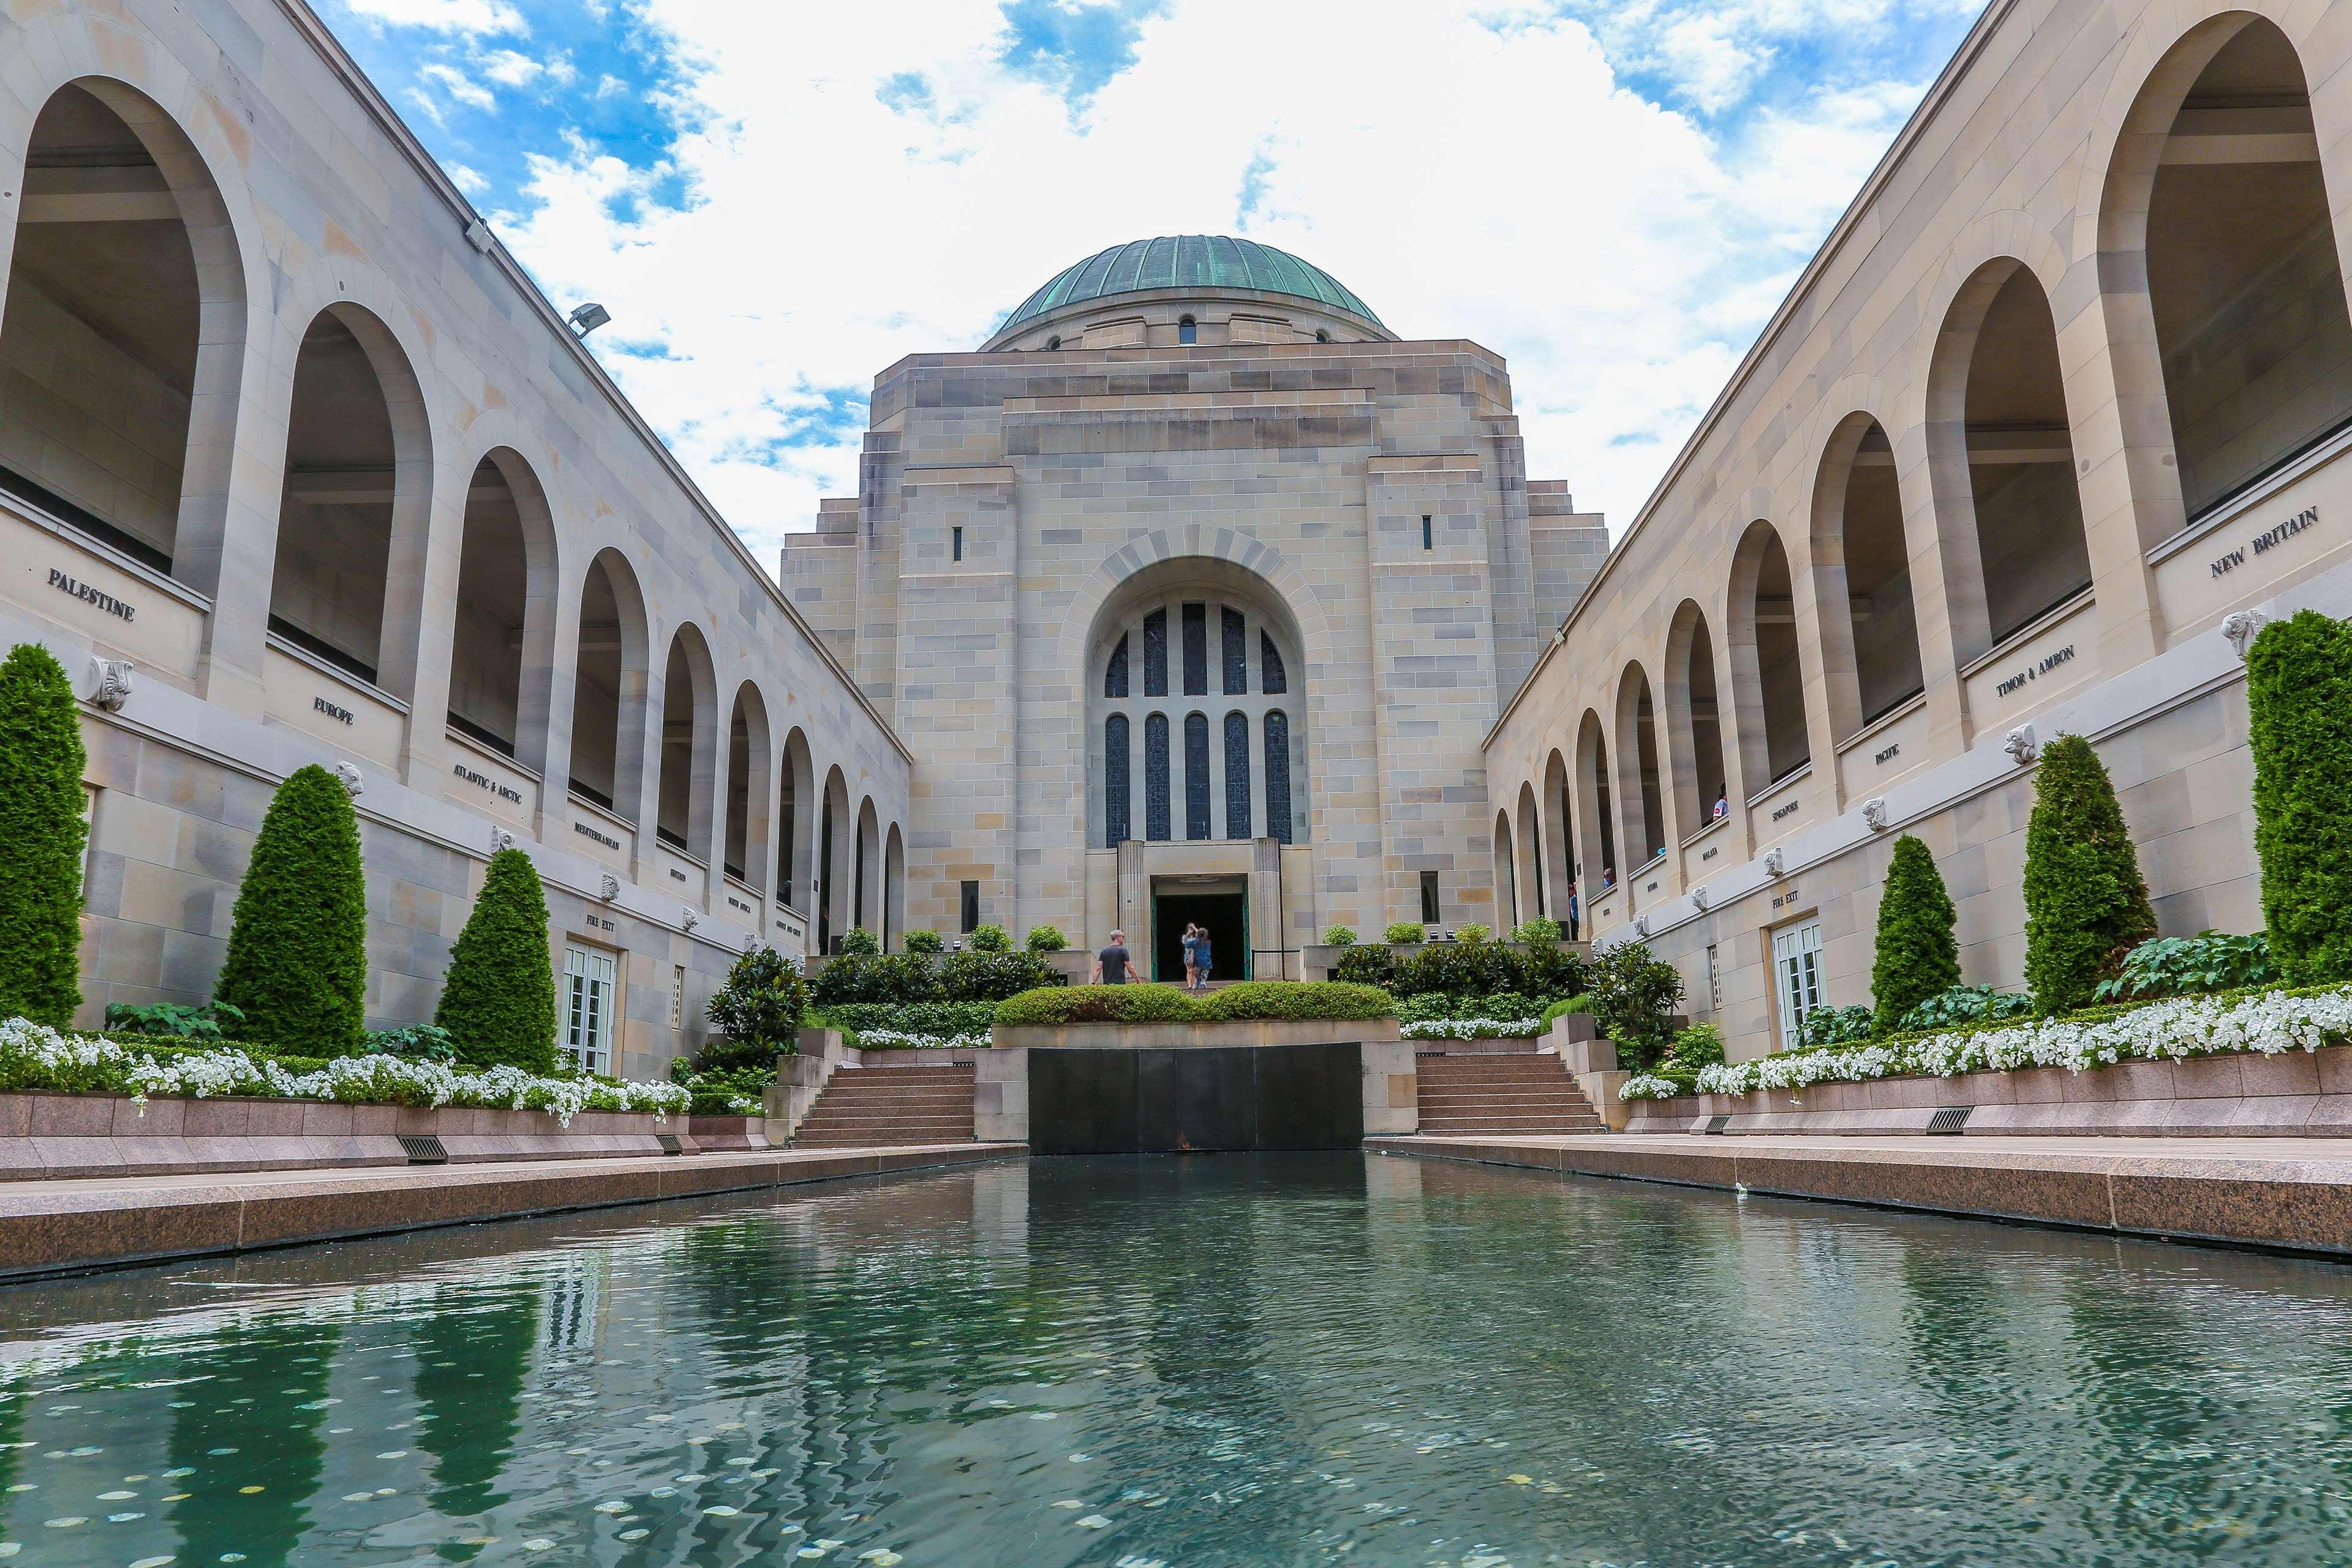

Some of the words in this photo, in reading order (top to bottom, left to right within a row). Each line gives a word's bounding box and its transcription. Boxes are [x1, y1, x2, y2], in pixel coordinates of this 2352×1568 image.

[2210, 546, 2244, 578] NEW
[2251, 505, 2318, 556] BRITAIN
[47, 568, 135, 622] PALESTINE
[1996, 673, 2027, 697] TIMOR
[2028, 667, 2035, 680] &
[2038, 644, 2075, 675] AMBON
[314, 696, 354, 725] EUROPE
[1875, 744, 1899, 764] PACIFIC
[453, 764, 489, 789] ATLANTIC
[491, 782, 497, 793] &
[499, 785, 522, 804] ARCTIC
[1772, 800, 1798, 821] SINGAPORE
[575, 822, 620, 850] MEDITERRANEAN
[1702, 846, 1717, 861] MALAYA
[670, 868, 686, 882] BRITAIN
[1773, 897, 1784, 909] FIRE
[1785, 890, 1798, 903] EXIT
[587, 914, 599, 927] FIRE
[601, 919, 615, 932] EXIT
